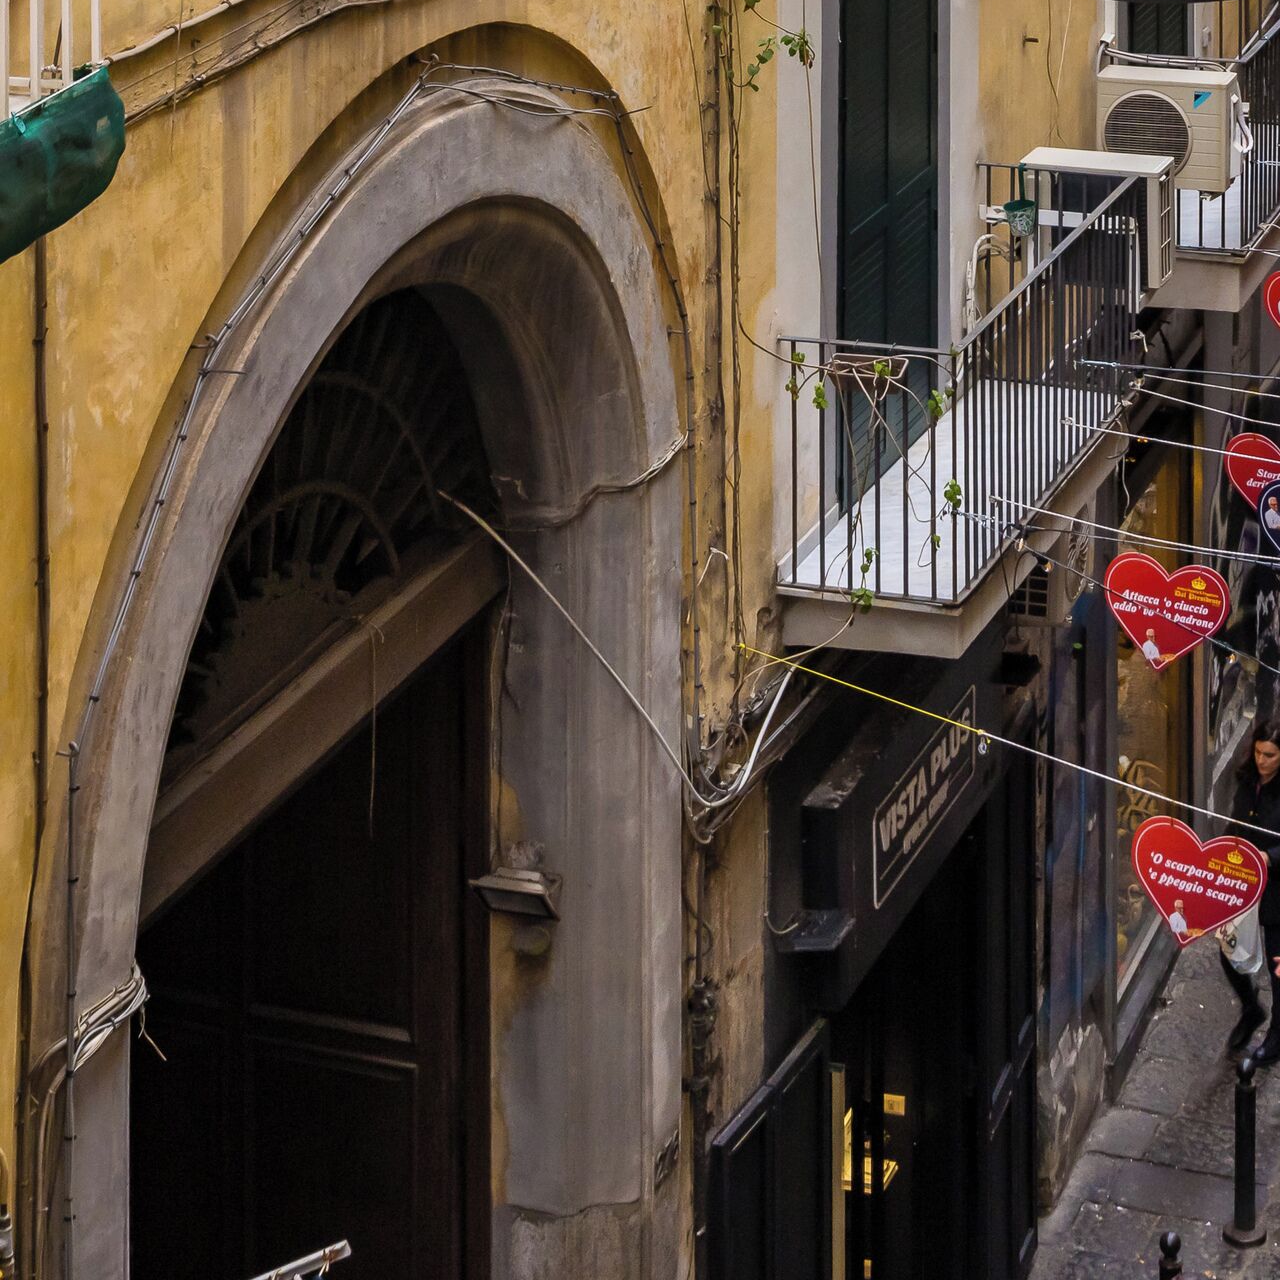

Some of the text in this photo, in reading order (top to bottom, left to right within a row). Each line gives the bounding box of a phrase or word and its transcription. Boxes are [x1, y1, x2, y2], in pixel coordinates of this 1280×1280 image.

[1113, 602, 1141, 613] addo'
[1174, 614, 1214, 628] padrone
[1121, 589, 1208, 615] Attacca 'o ciuccio
[879, 767, 928, 852] VISTA
[930, 707, 970, 786] PLUS
[1148, 868, 1244, 906] 'e ppeggio scarpe
[1150, 851, 1163, 865] 'O
[1165, 859, 1215, 880] scarparo
[1215, 873, 1248, 892] porta
